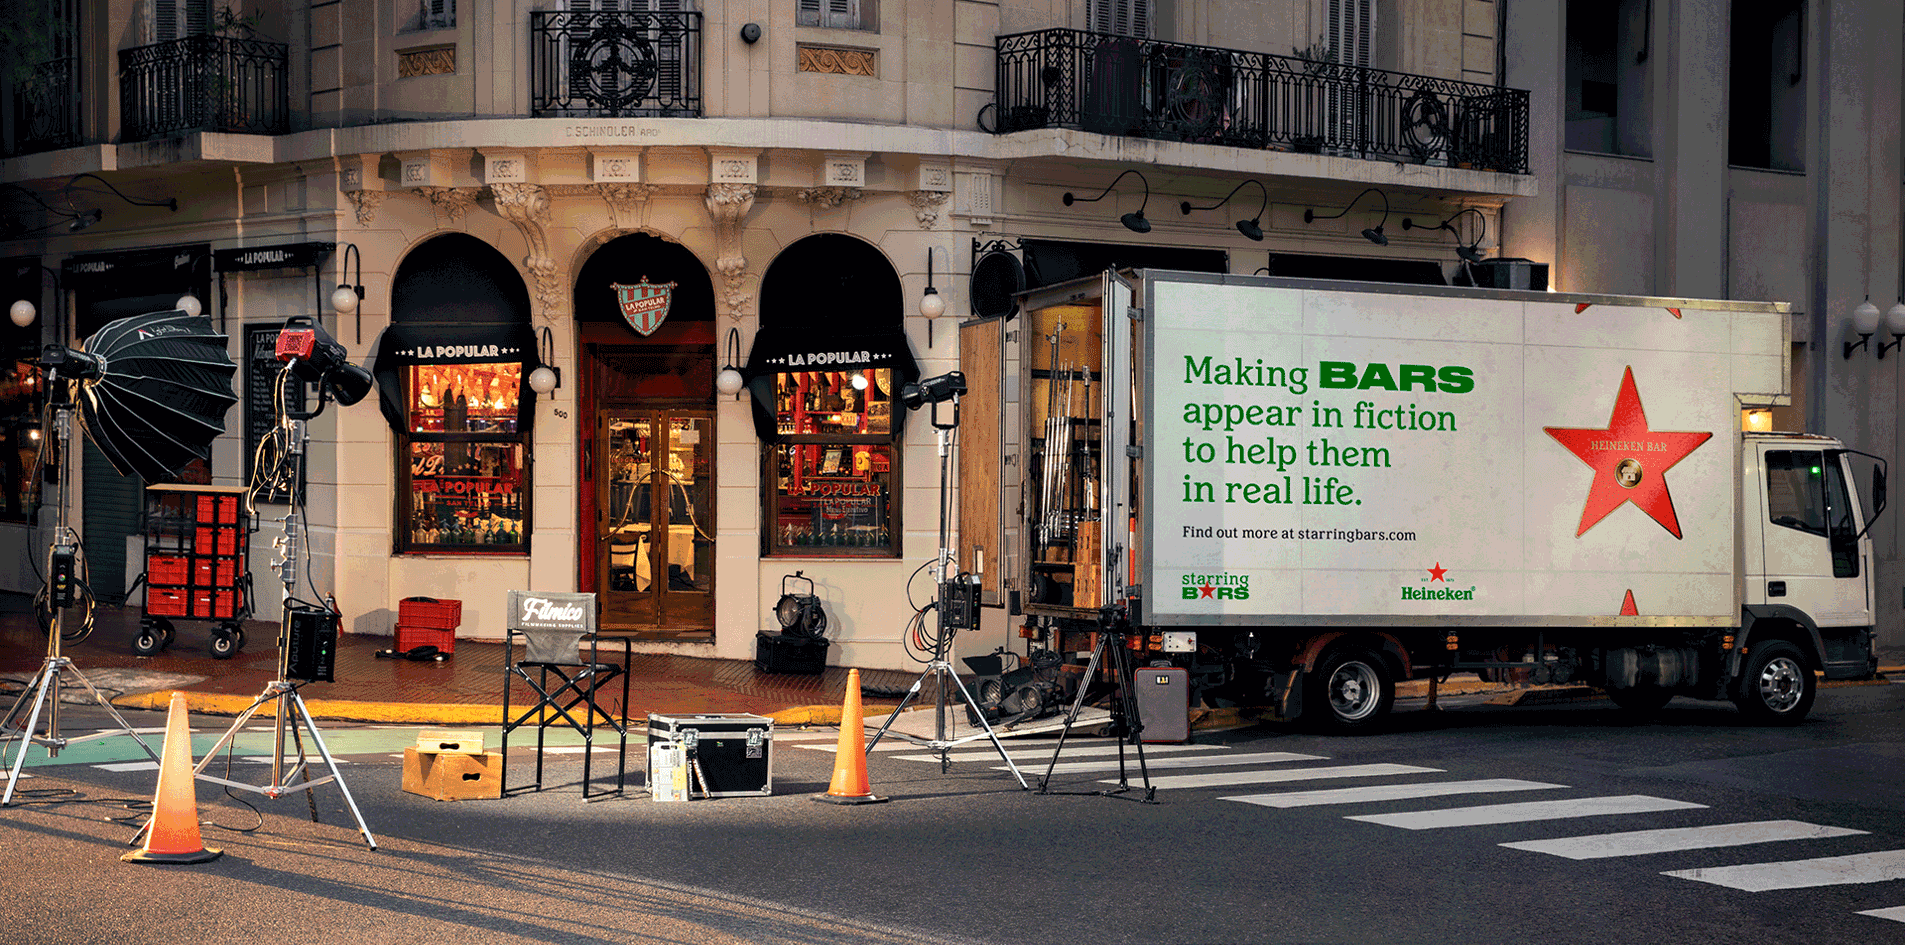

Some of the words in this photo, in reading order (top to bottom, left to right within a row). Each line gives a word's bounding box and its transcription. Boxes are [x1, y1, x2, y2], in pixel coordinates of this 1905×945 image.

[245, 252, 252, 264] LA
[254, 250, 284, 263] POPULAR
[625, 303, 635, 311] LA
[635, 297, 665, 309] POPULAR
[417, 346, 434, 358] LA
[436, 345, 499, 358] POPULAR
[788, 354, 805, 366] LA
[807, 351, 871, 364] POPULAR
[1183, 355, 1309, 395] Making
[1319, 361, 1475, 394] BARS
[553, 408, 568, 419] 500
[1183, 402, 1303, 431] appear
[1311, 400, 1344, 428] in
[1353, 401, 1458, 431] fiction
[1590, 441, 1643, 451] HEINEKEN
[1647, 442, 1667, 452] BAR
[1182, 436, 1216, 463] to
[1225, 436, 1297, 472] help
[1306, 438, 1391, 468] them
[422, 481, 440, 493] LA
[444, 481, 513, 494] POPULAR
[786, 484, 805, 495] LA
[810, 483, 881, 496] POPULAR
[1182, 474, 1216, 503] in
[1225, 476, 1293, 504] real
[1302, 476, 1362, 506] life.
[1182, 526, 1213, 538] Find
[1216, 528, 1238, 539] out
[1242, 529, 1278, 539] more
[1281, 528, 1295, 539] at
[1298, 528, 1417, 543] starringbars.com
[1182, 572, 1249, 588] starring
[1182, 587, 1250, 600] BRS
[522, 597, 583, 621] Filmico
